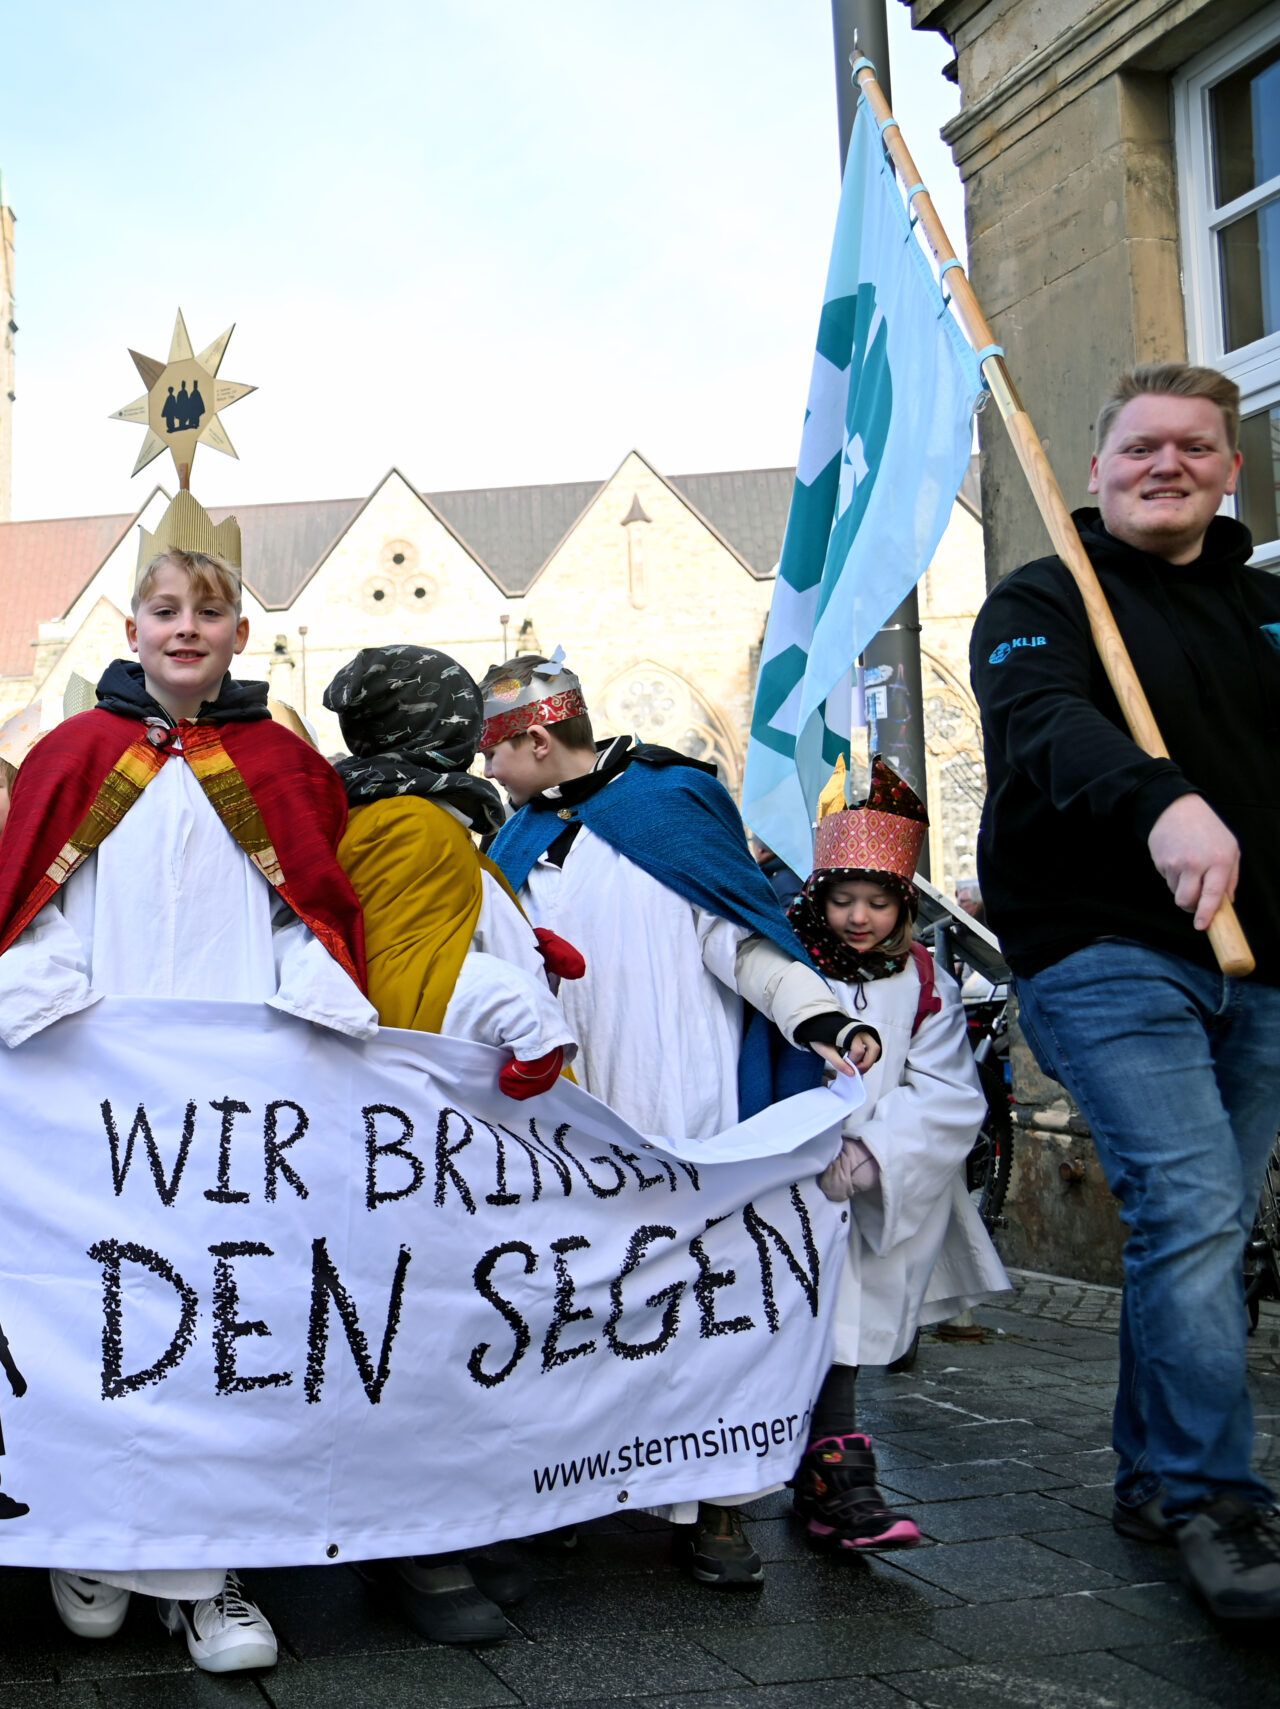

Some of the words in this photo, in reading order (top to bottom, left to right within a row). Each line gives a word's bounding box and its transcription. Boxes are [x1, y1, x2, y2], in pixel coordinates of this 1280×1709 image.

[1012, 636, 1047, 648] KLJB
[100, 1096, 309, 1207] WIR
[361, 1103, 701, 1215] BRINGEN
[88, 1237, 412, 1404] DEN
[467, 1182, 820, 1388] SEGEN
